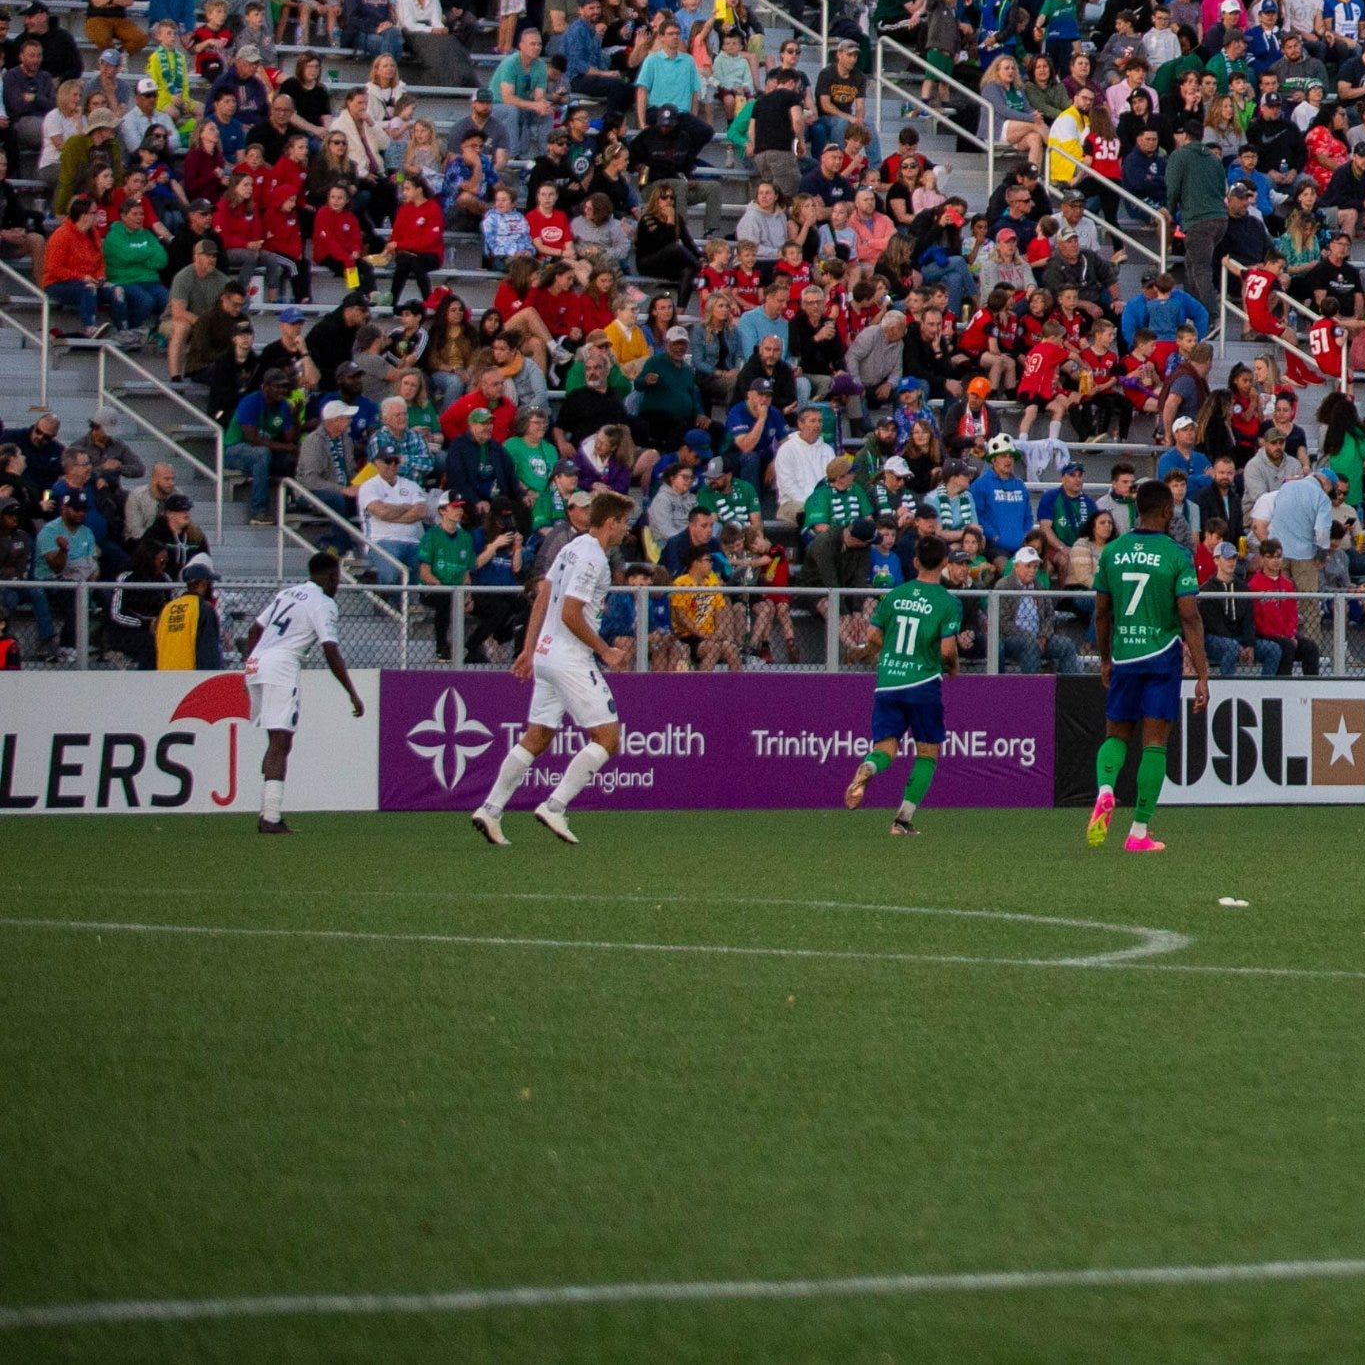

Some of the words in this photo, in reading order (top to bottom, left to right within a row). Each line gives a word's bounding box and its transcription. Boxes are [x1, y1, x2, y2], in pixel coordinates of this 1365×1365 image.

[1309, 327, 1331, 355] 51
[1114, 552, 1162, 567] SAYDEE
[1121, 572, 1151, 616] 7
[266, 597, 297, 636] 14
[895, 615, 921, 655] 11
[618, 723, 706, 756] ealth
[1166, 698, 1308, 786] USL
